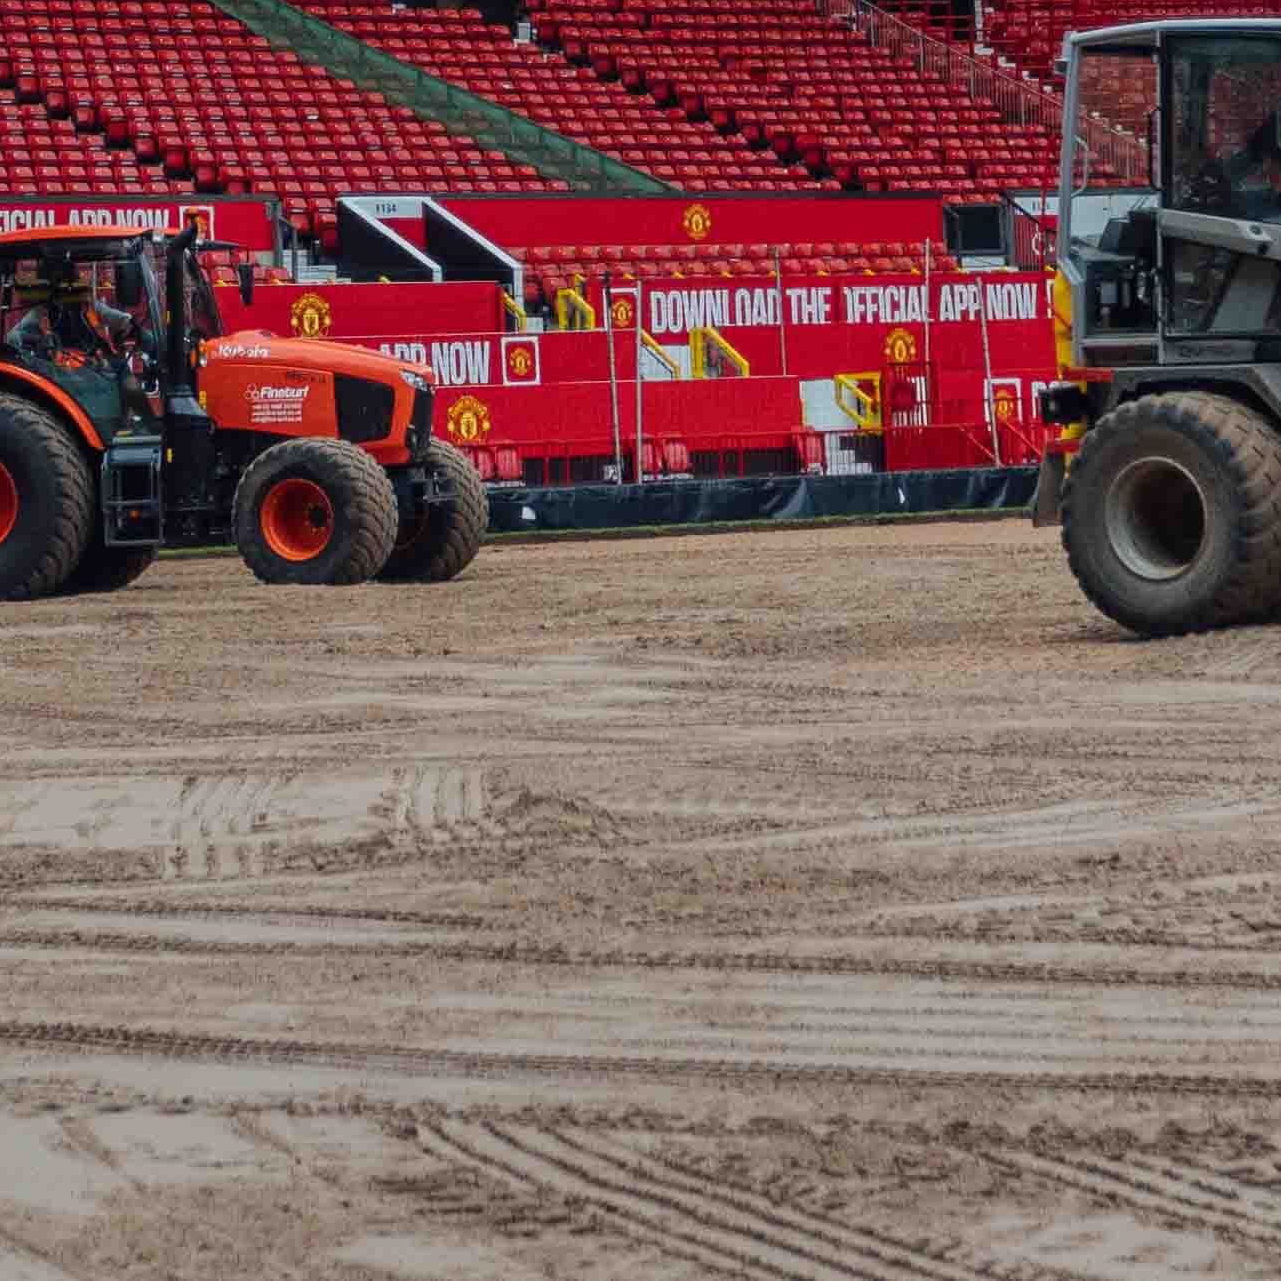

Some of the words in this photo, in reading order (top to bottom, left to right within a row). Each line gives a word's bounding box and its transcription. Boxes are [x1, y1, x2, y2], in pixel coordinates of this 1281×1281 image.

[650, 287, 782, 334] DOWNLOAD
[786, 286, 831, 325] THE
[940, 284, 983, 322] APP
[987, 283, 1037, 321] NOW
[432, 341, 490, 385] NOW
